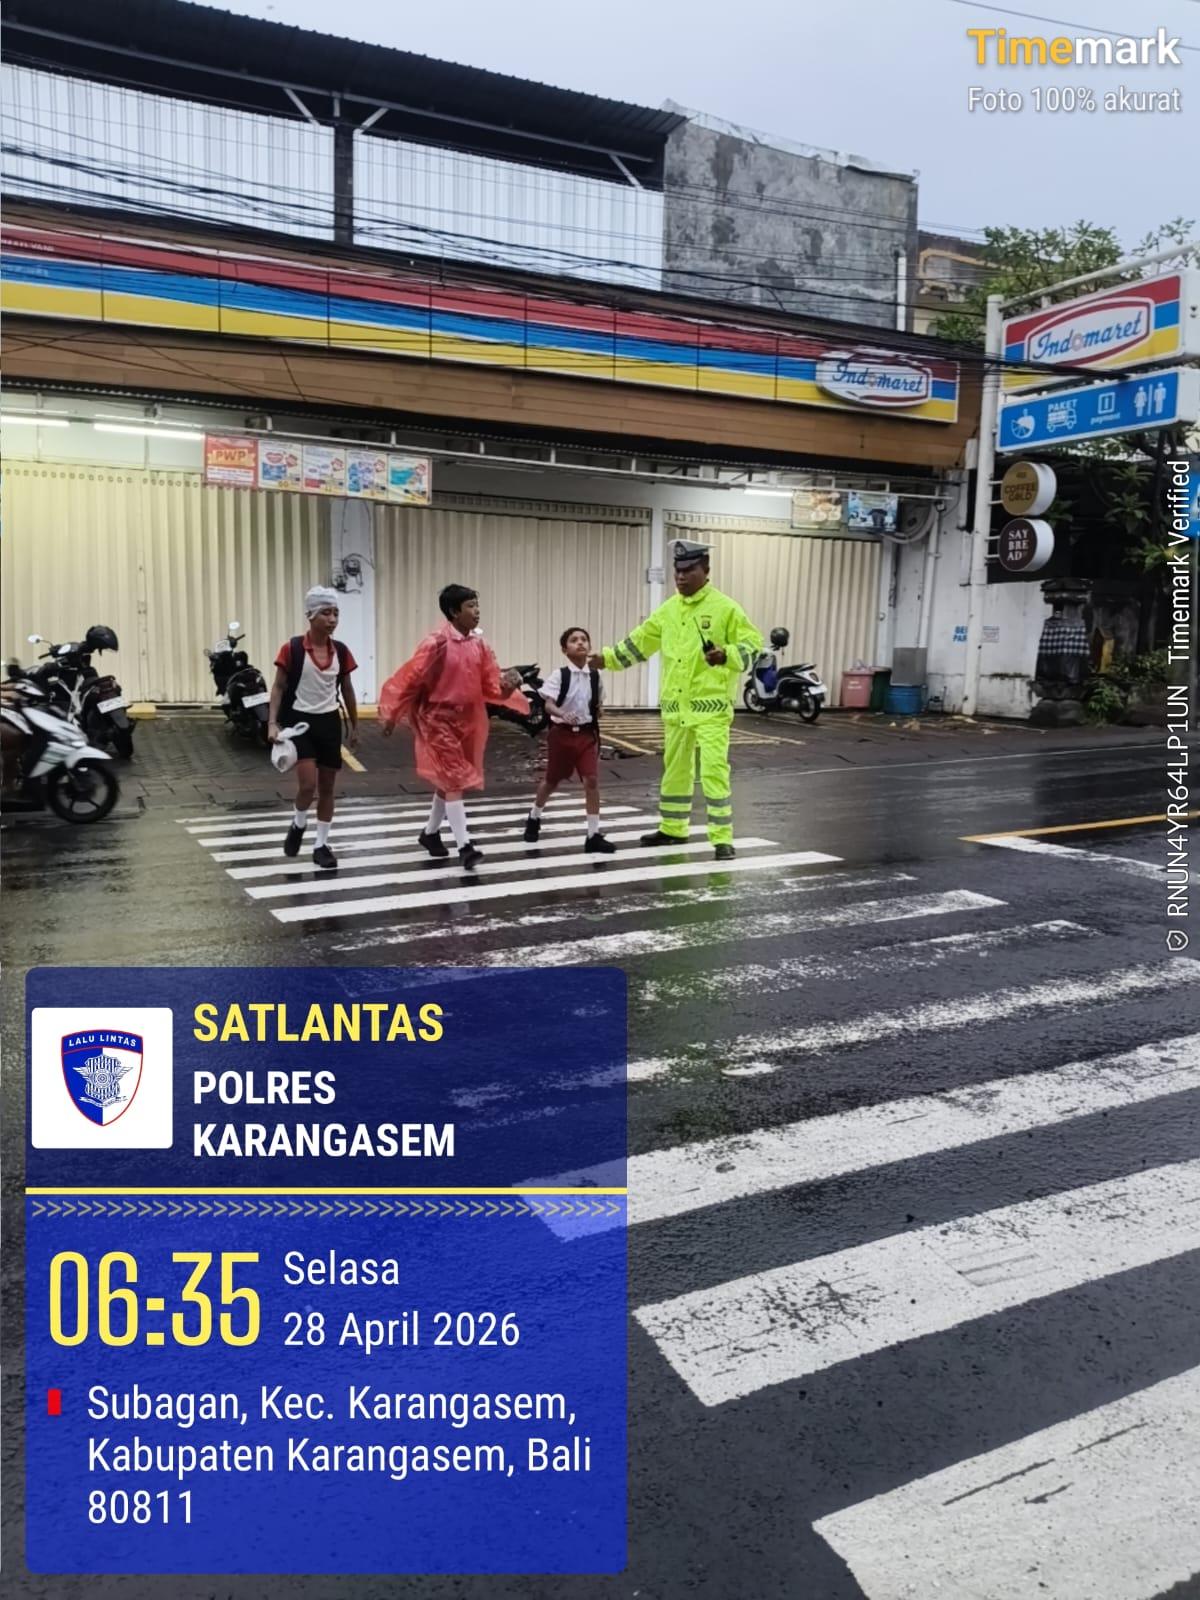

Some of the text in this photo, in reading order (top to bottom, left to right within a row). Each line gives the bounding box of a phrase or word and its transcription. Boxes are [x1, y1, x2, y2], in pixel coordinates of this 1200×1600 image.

[1033, 311, 1143, 360] Indomaret
[831, 362, 923, 393] Indomaret
[1048, 398, 1078, 412] PAKET
[215, 450, 247, 461] PWP
[1008, 528, 1029, 540] SAY
[1008, 540, 1029, 551] BRE
[1007, 550, 1022, 562] AD
